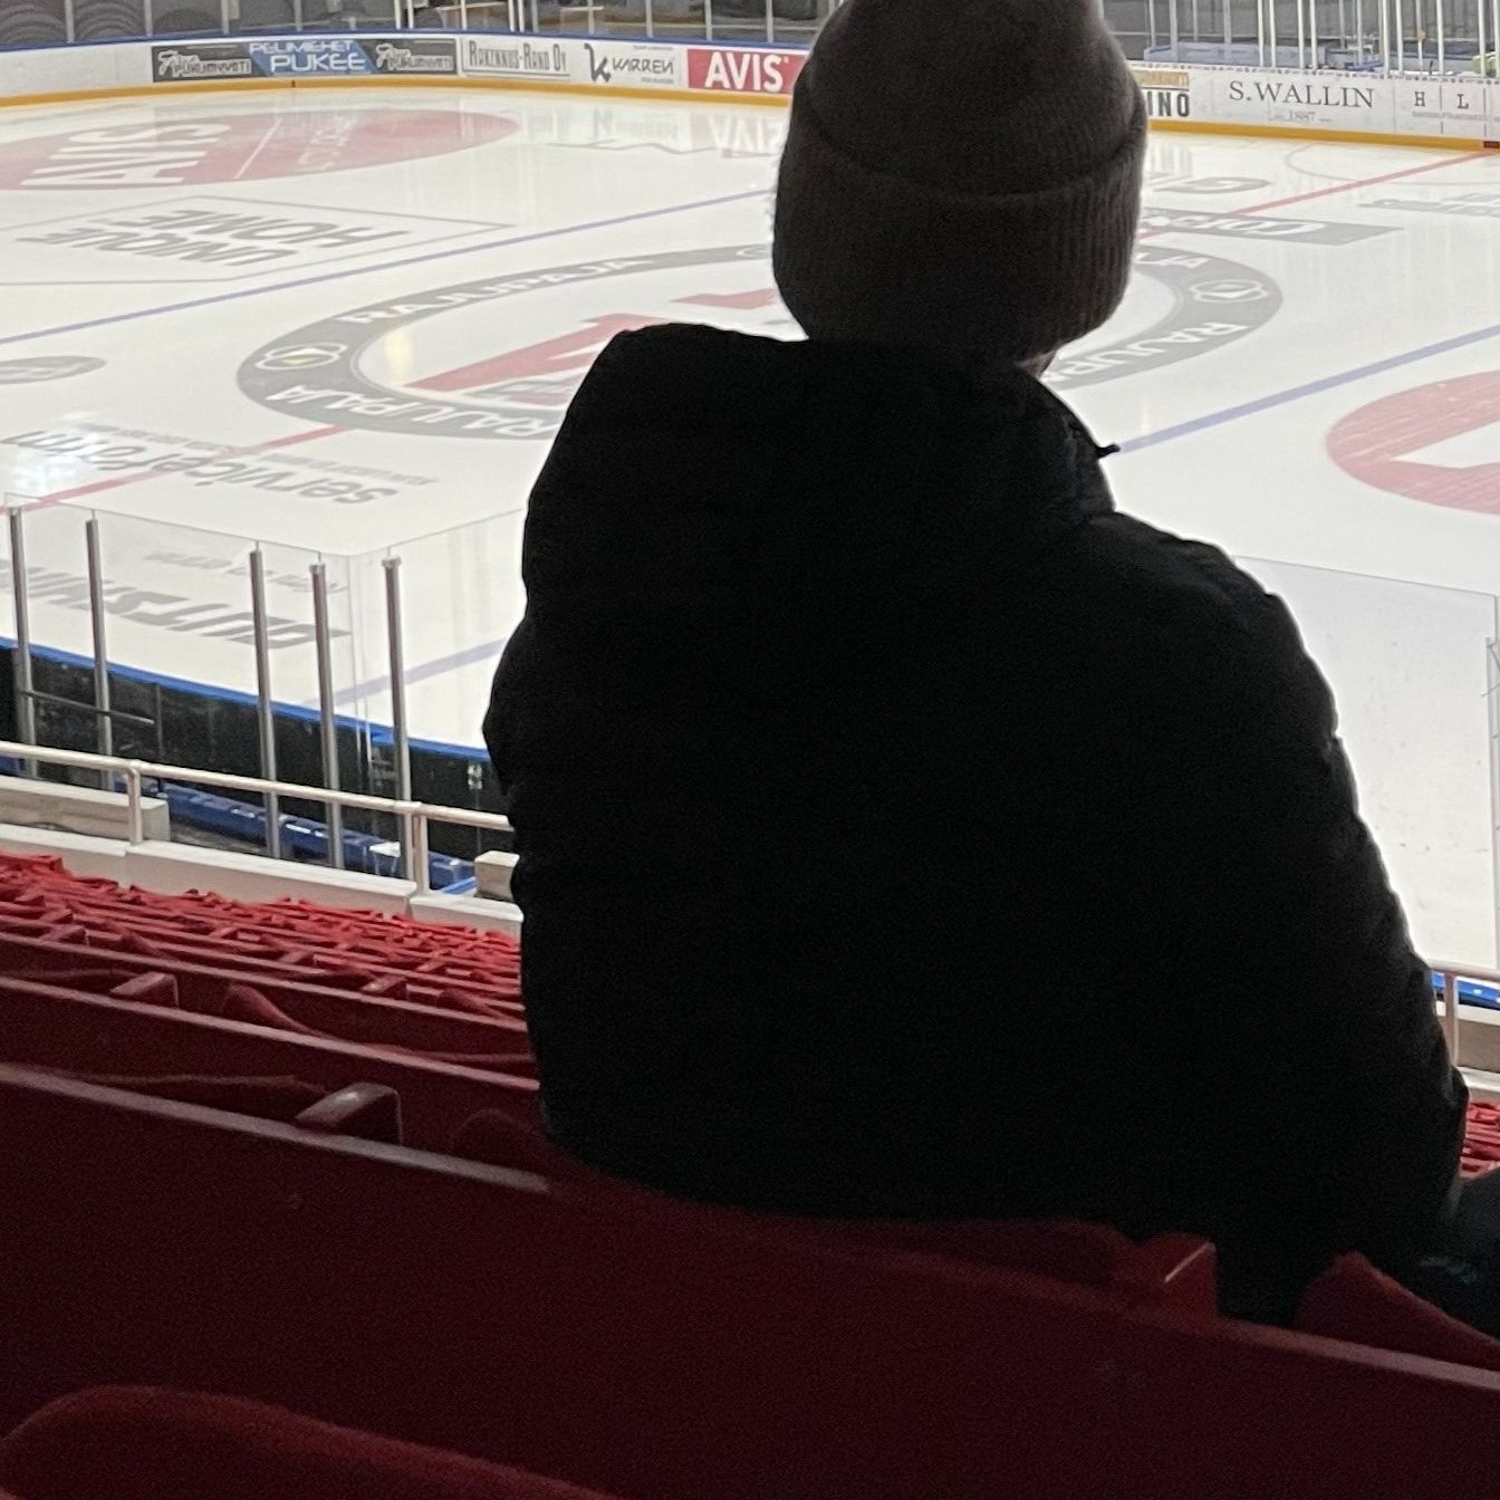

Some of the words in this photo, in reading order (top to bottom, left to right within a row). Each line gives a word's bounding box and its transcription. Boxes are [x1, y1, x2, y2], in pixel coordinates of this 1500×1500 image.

[270, 53, 367, 73] PUKEE
[704, 51, 785, 92] AVIS
[20, 122, 231, 187] AVIS
[15, 227, 298, 267] UNIQUE
[110, 209, 410, 249] HOME
[265, 385, 560, 437] RAJUPAJA
